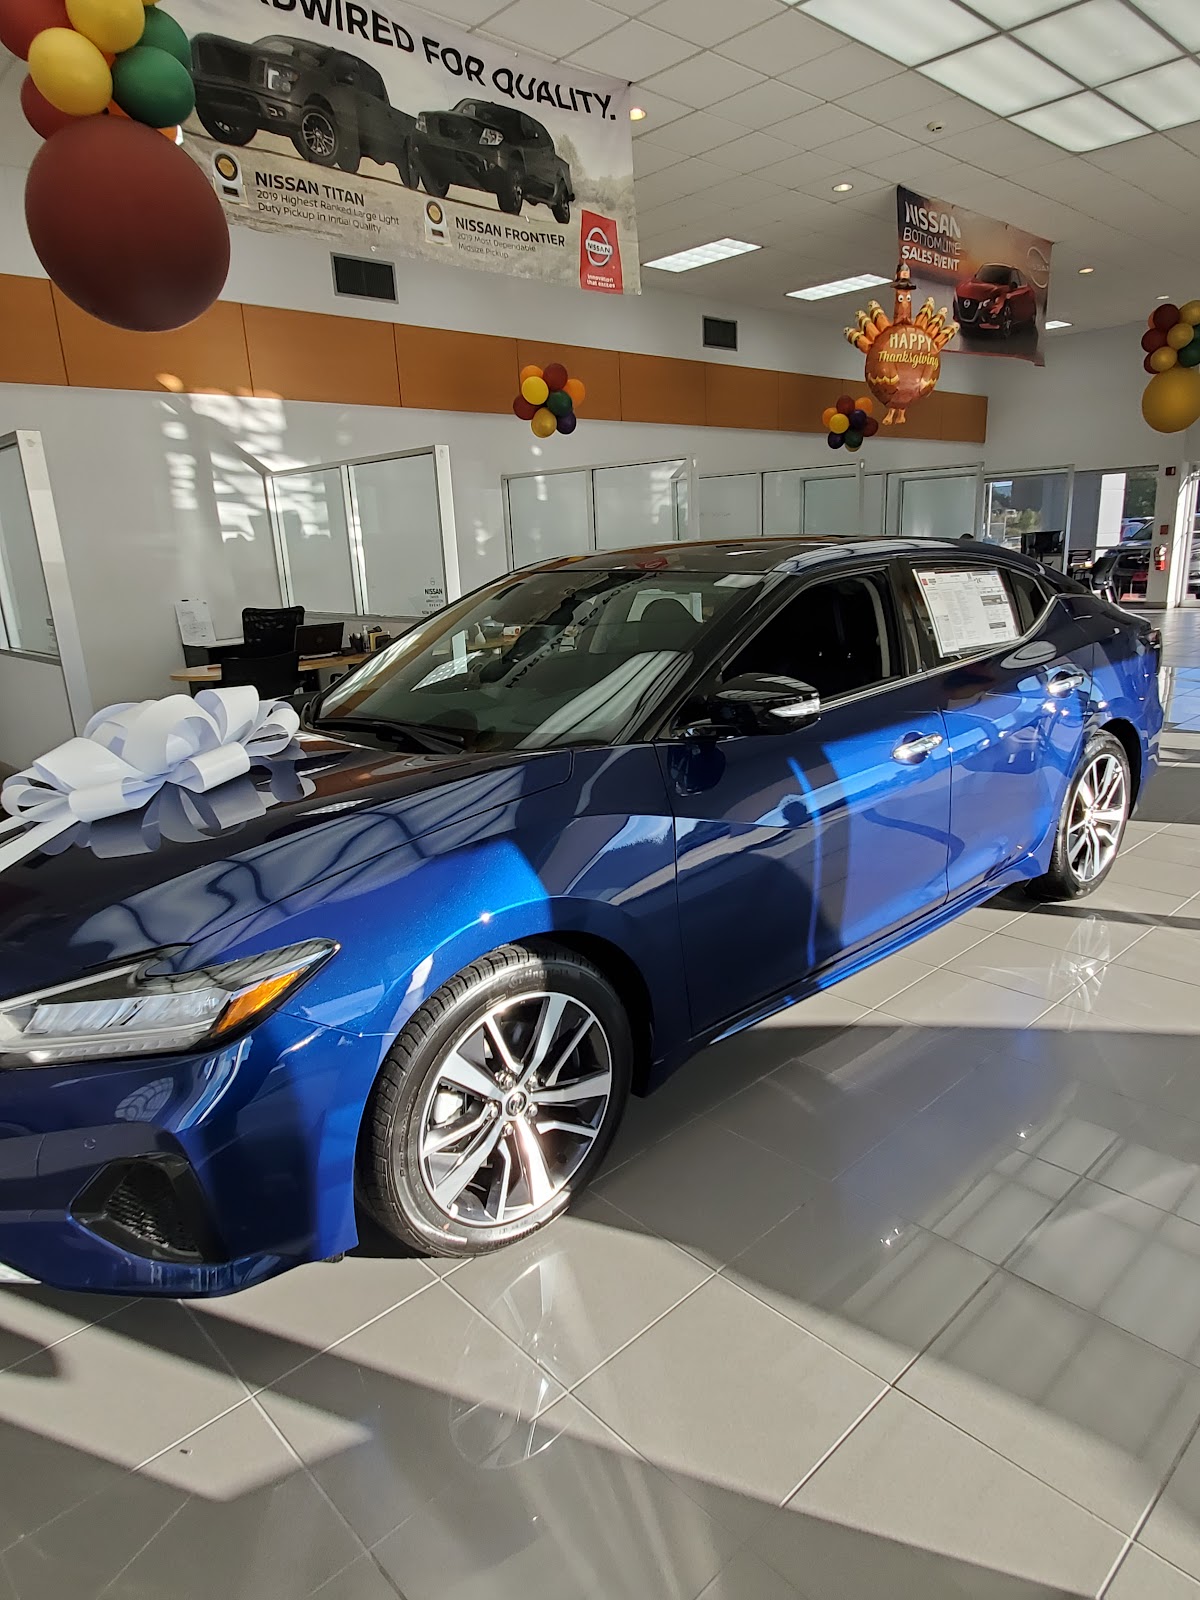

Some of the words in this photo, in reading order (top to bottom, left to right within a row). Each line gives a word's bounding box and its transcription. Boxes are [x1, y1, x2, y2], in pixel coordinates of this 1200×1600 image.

[421, 36, 487, 87] FOR
[491, 68, 617, 120] QUALITY.
[255, 171, 319, 196] NISSAN
[322, 184, 365, 207] TITAN
[256, 189, 278, 201] 2019
[281, 194, 318, 210] Highest
[320, 199, 351, 216] Ranked
[353, 207, 377, 222] Large
[378, 213, 400, 226] Light
[258, 202, 281, 216] Duty
[283, 207, 315, 221] Pickup
[317, 212, 326, 222] in
[328, 213, 351, 226] Initial
[353, 219, 382, 235] Quality
[904, 201, 961, 239] NISSAN
[455, 215, 501, 238] NISSAN
[505, 227, 565, 247] FRONTIER
[457, 232, 473, 242] 2019
[474, 235, 491, 246] Most
[493, 239, 536, 253] Dependable
[903, 226, 942, 251] BOTTOM
[942, 239, 961, 256] LINE
[458, 242, 484, 254] Midsize
[485, 247, 509, 259] Pickup
[587, 242, 611, 254] NISSAN
[901, 245, 932, 265] SALES
[933, 253, 960, 272] EVENT
[890, 333, 932, 352] HAPPY
[878, 350, 939, 370] Thanksgiving
